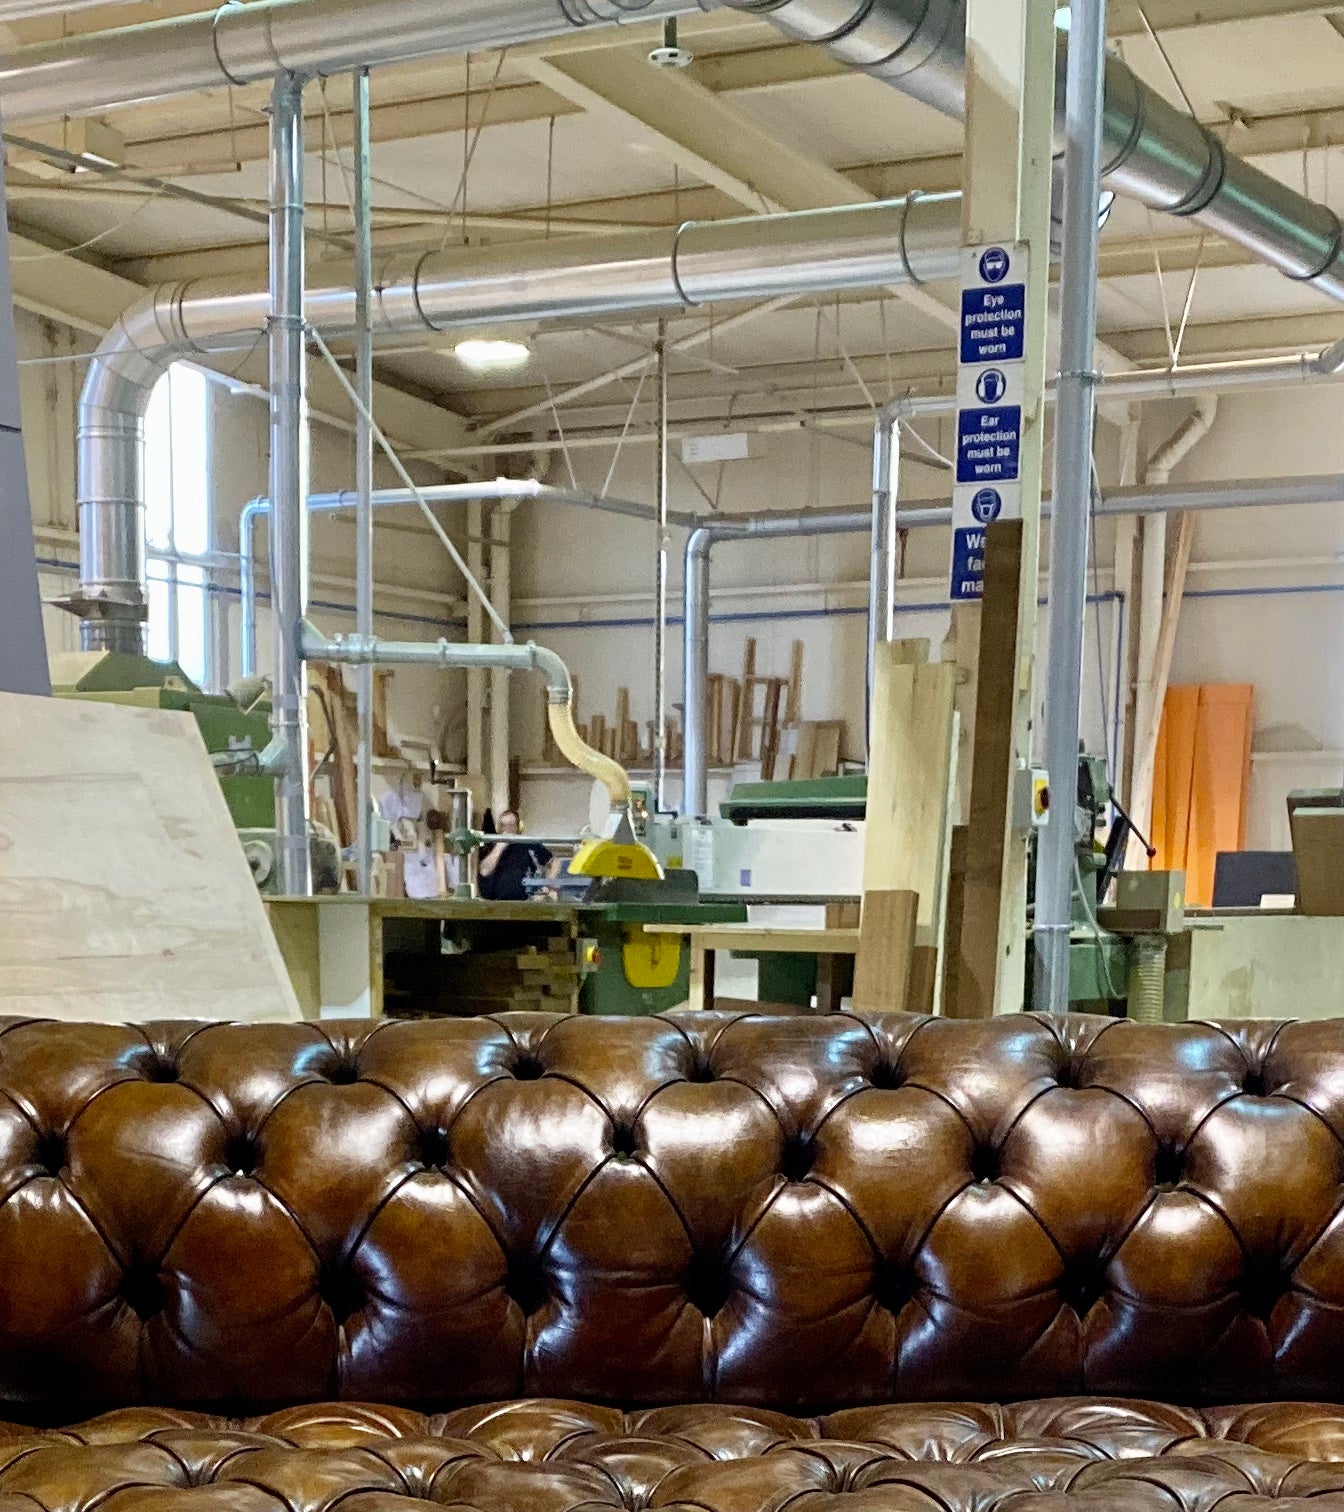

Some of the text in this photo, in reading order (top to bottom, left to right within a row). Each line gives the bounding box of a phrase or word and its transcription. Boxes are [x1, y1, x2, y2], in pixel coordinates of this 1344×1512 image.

[983, 294, 1004, 309] Eye
[965, 309, 1022, 326] protection
[971, 324, 1015, 339] must be
[978, 343, 1007, 355] worn
[980, 415, 1000, 427] Ear
[962, 430, 1017, 446] protection
[967, 445, 1011, 460] must be
[974, 463, 1002, 474] worn
